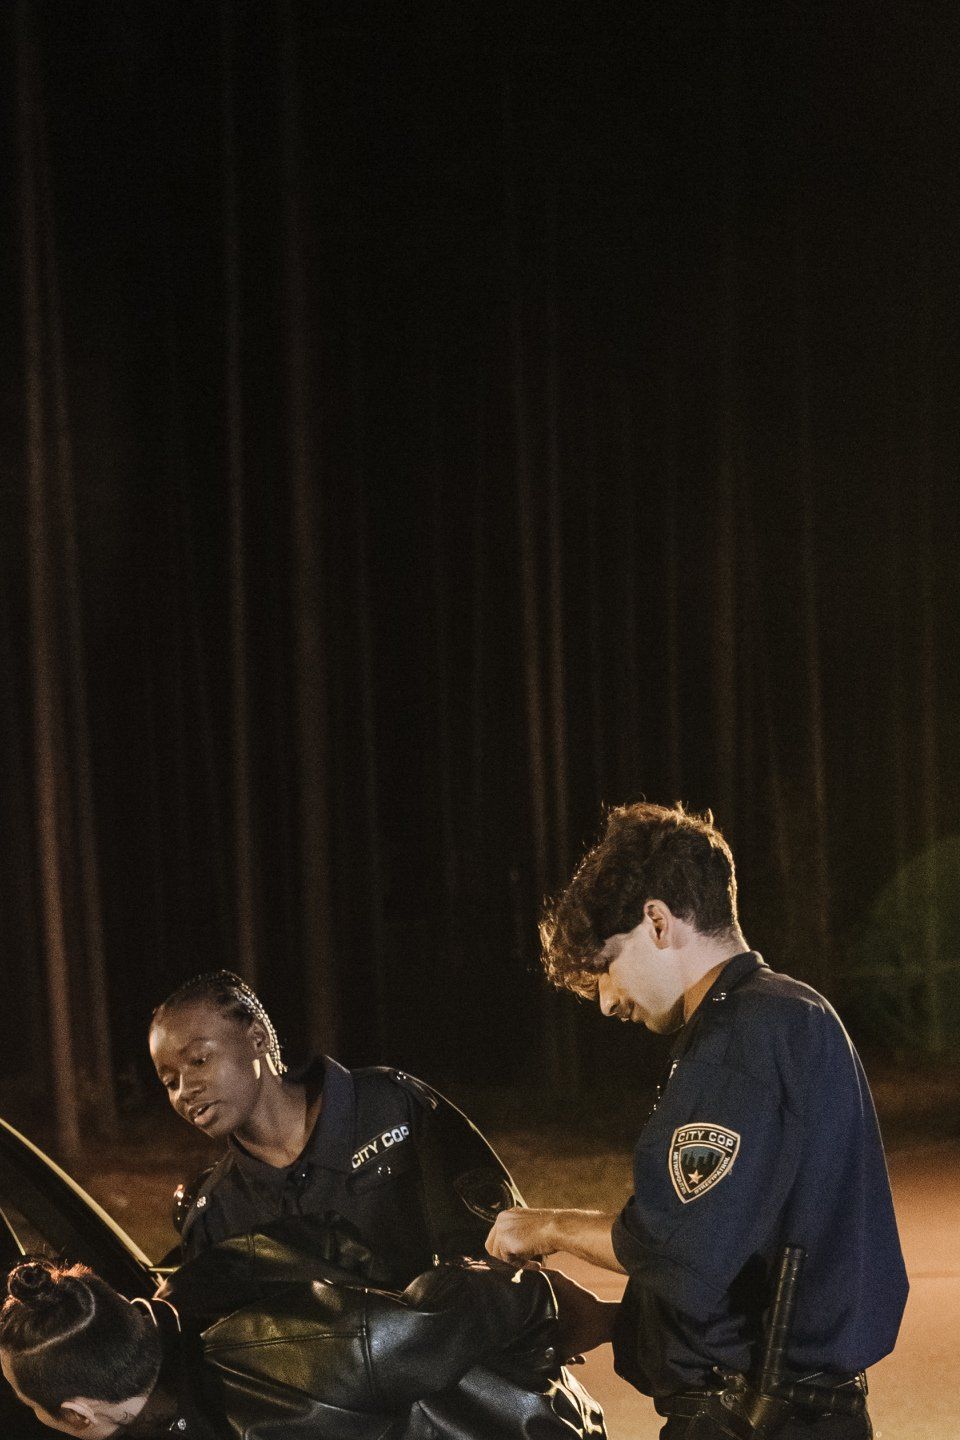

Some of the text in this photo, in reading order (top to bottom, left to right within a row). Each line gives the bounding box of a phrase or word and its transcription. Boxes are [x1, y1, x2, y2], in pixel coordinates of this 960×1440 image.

[677, 1130, 734, 1148] CITY COP
[351, 1141, 379, 1169] CITY
